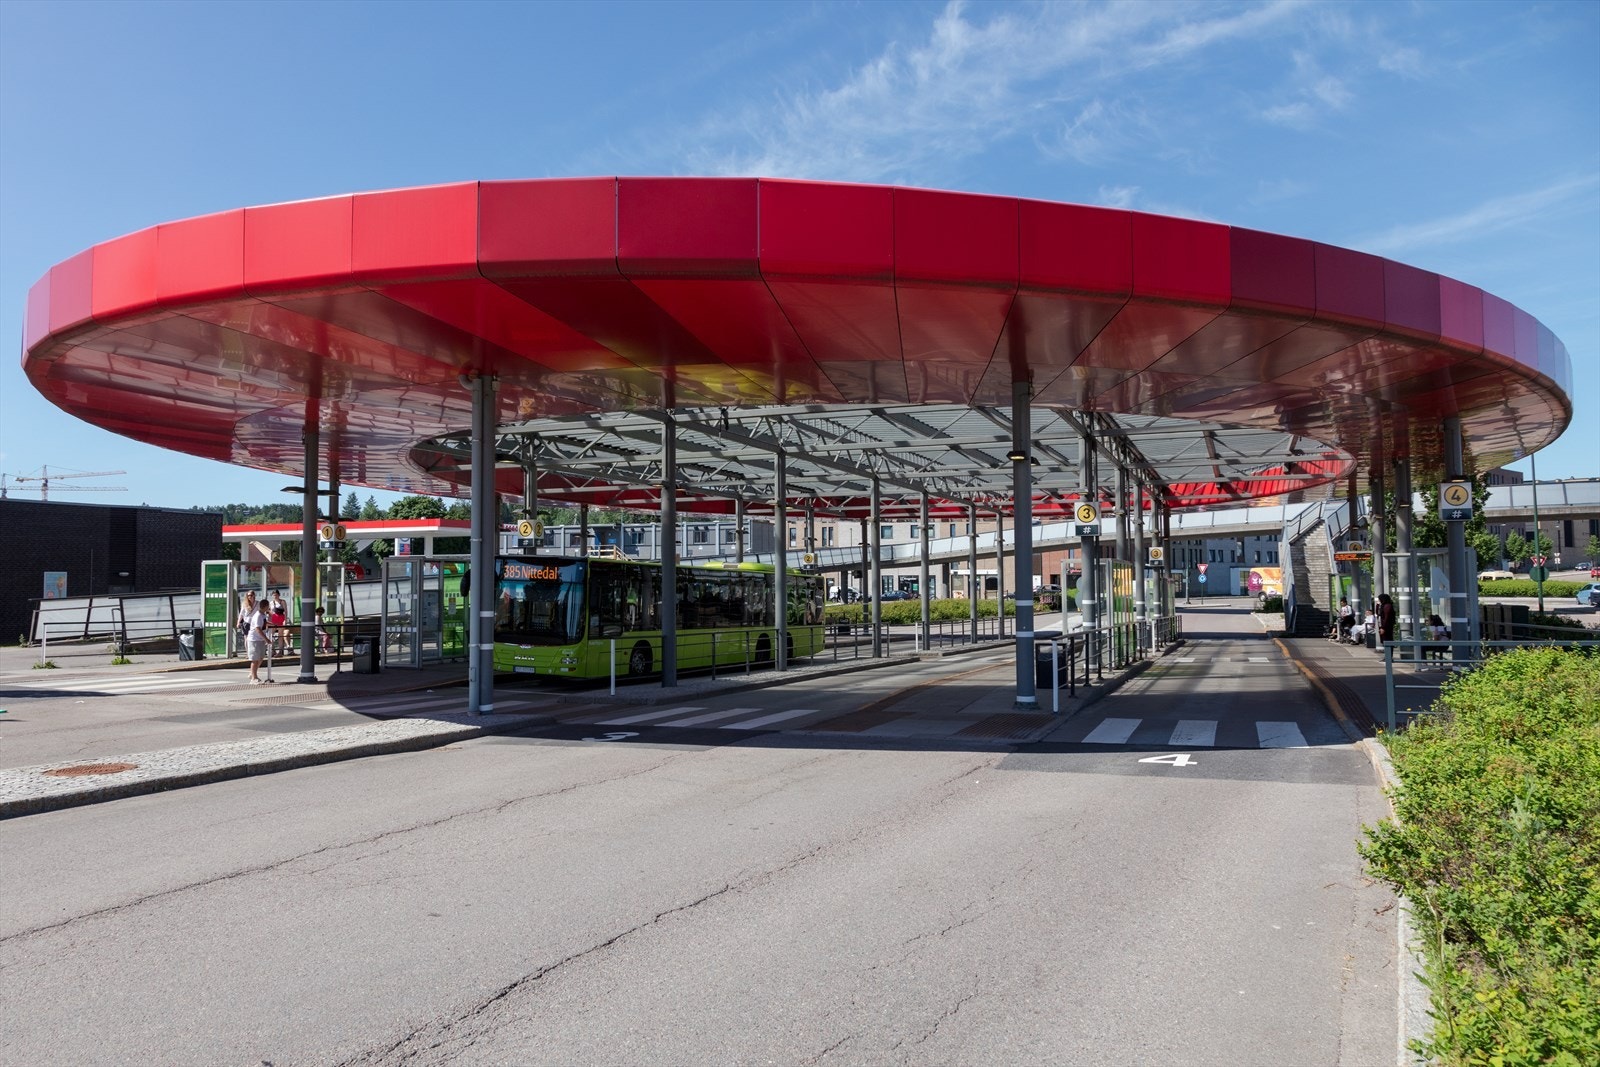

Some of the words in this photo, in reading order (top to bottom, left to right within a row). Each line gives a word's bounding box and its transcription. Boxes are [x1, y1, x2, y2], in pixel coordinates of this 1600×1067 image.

[1450, 488, 1461, 502] 4
[1083, 508, 1091, 519] 3
[522, 524, 529, 534] 2
[504, 565, 521, 578] 385
[521, 565, 558, 580] Nittedal
[1138, 753, 1198, 767] 4
